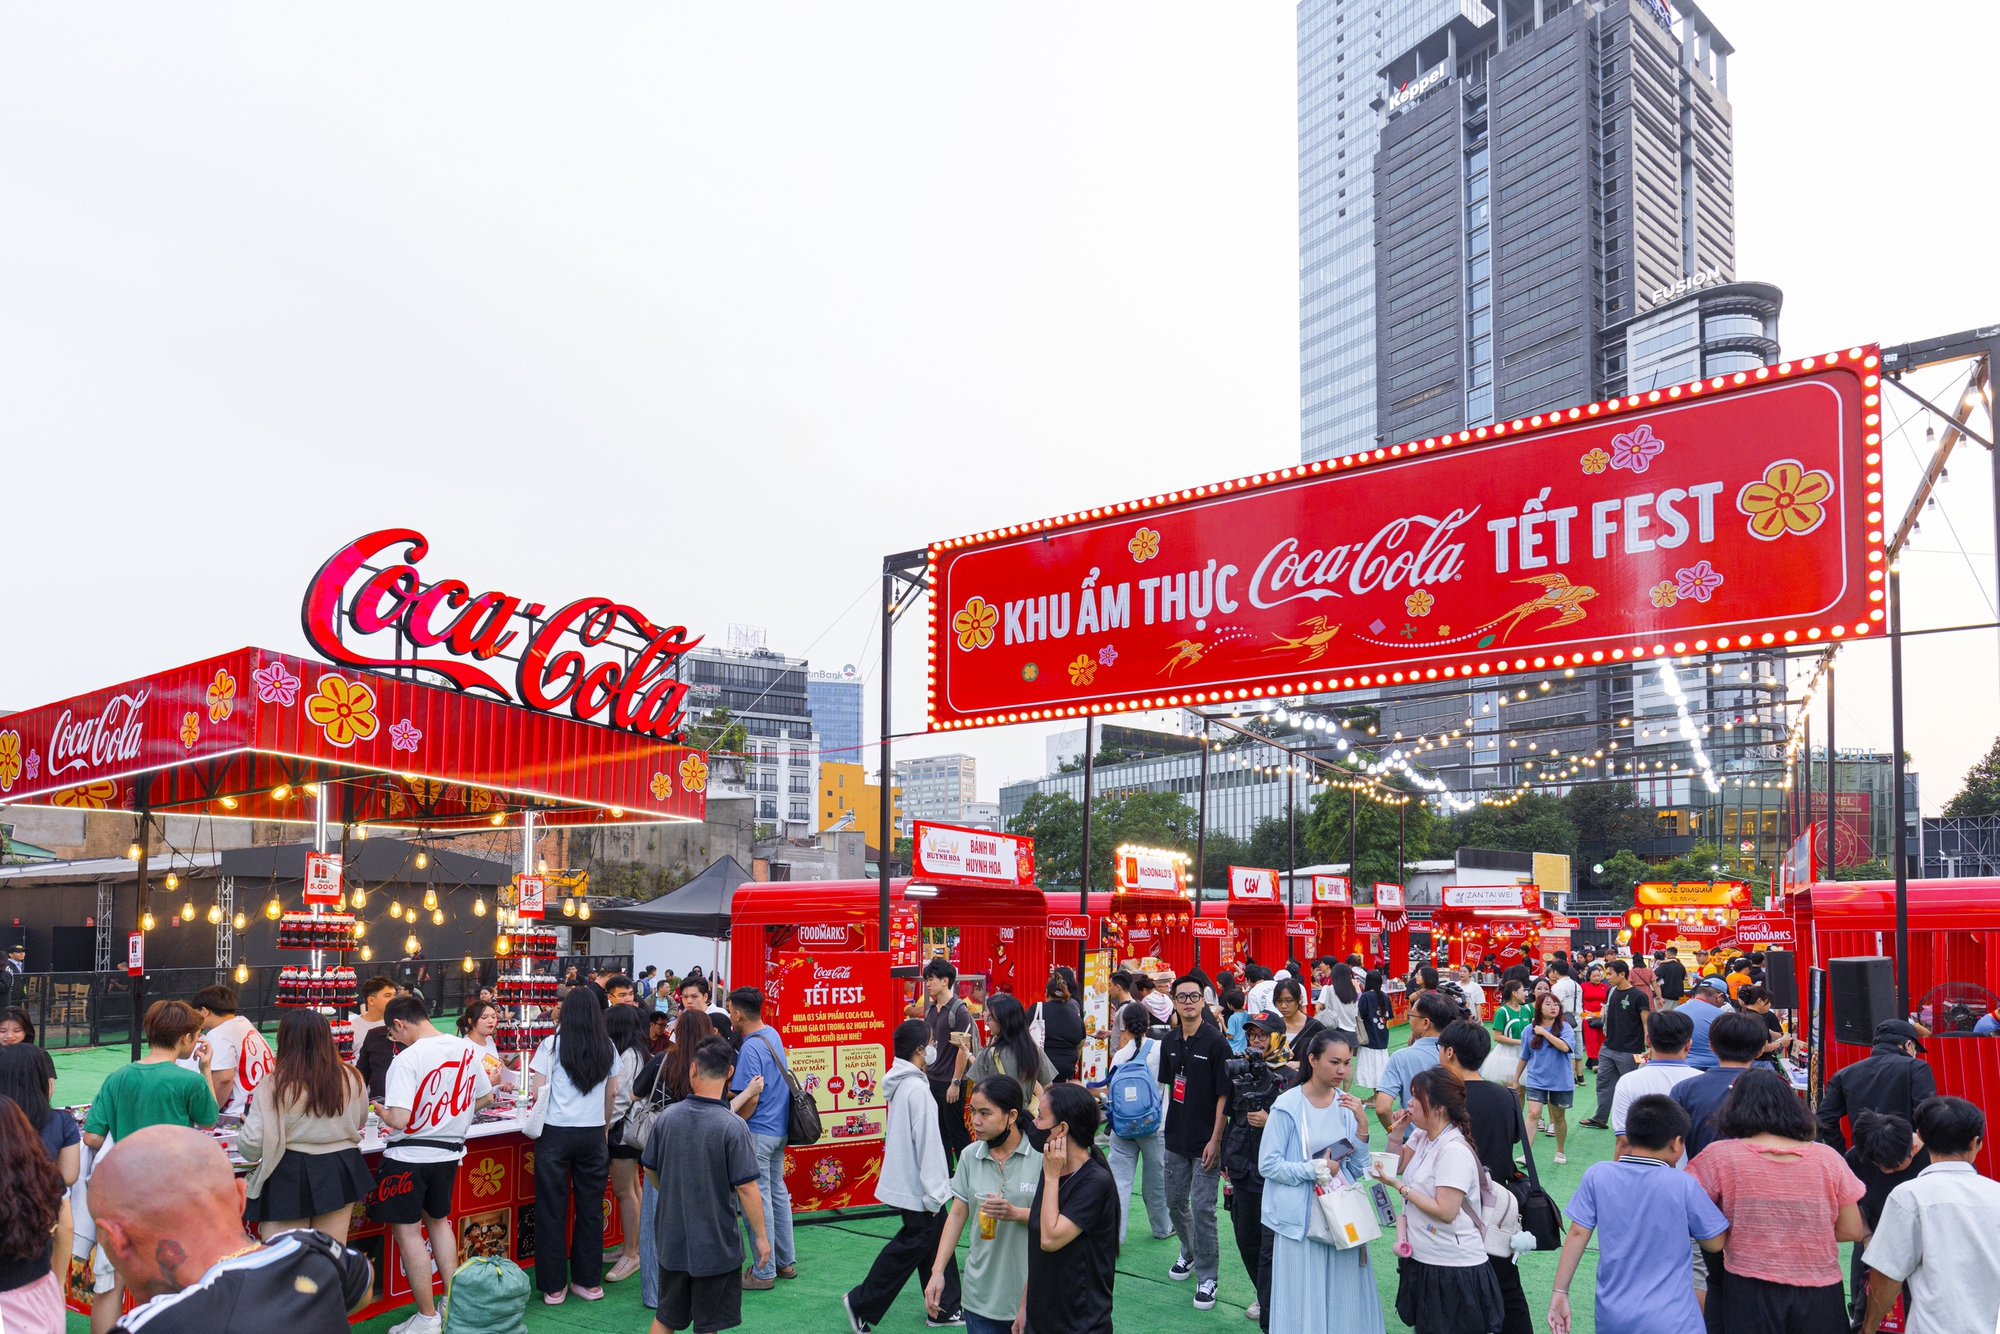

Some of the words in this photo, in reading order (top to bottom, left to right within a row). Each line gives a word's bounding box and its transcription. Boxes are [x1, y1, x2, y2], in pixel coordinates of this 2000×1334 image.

[1389, 62, 1444, 111] Keppel
[1652, 265, 1720, 304] FUSION
[1004, 592, 1070, 646] KHU
[1076, 566, 1130, 636] ẨM
[1139, 558, 1238, 631] THỰC
[1248, 504, 1481, 609] Coca-Cola
[1487, 487, 1578, 573] TẾT
[1593, 481, 1724, 559] FEST
[301, 528, 705, 740] Coca-Cola
[48, 686, 152, 776] Coca-Cola
[970, 837, 987, 855] BÁNH
[989, 839, 996, 856] MÌ
[926, 852, 948, 861] HUYNH
[948, 854, 960, 862] HOA
[966, 858, 987, 874] HUYNH
[988, 860, 1002, 875] HOA
[1140, 866, 1172, 879] McDONALD'S
[800, 926, 845, 940] FOODMARKS
[1048, 927, 1087, 936] FOODMARKS
[1129, 930, 1150, 938] FOODMARKS
[1194, 928, 1226, 936] FOODMARKS
[1740, 931, 1791, 940] FOODMARKS
[814, 966, 852, 980] Coca-Cola
[804, 981, 829, 1005] TẾT
[832, 987, 863, 1004] FEST
[845, 1011, 874, 1019] COCA-COLA
[854, 1022, 868, 1031] HOẠT
[869, 1019, 885, 1030] ĐỘNG
[836, 1033, 848, 1043] BẠN
[404, 1048, 476, 1134] Cola
[378, 1171, 414, 1202] Cola
